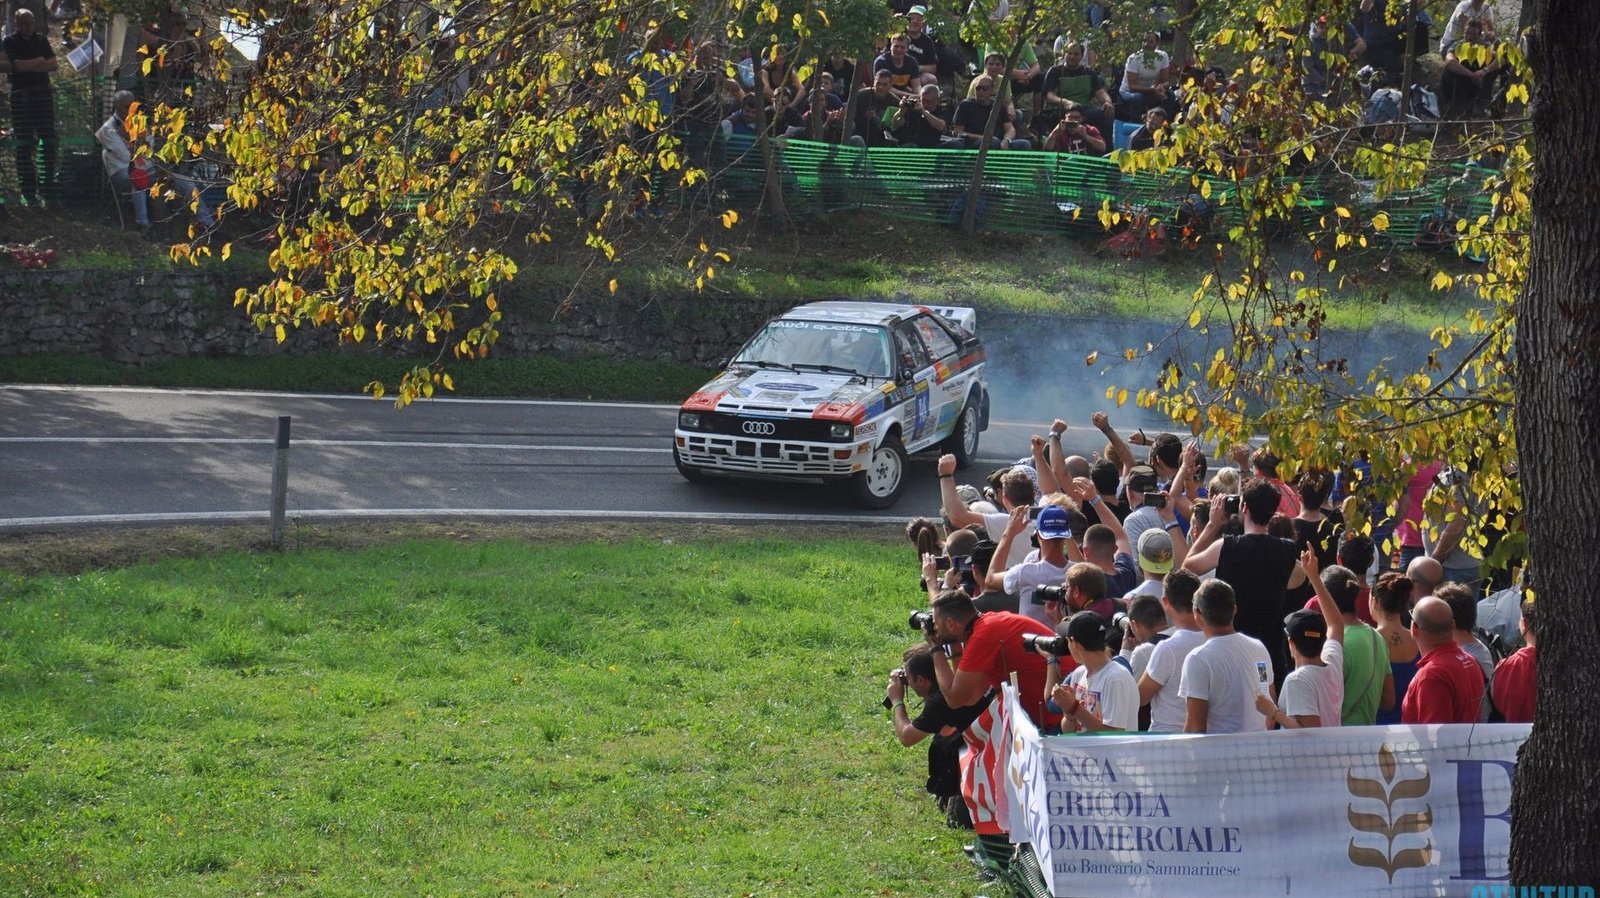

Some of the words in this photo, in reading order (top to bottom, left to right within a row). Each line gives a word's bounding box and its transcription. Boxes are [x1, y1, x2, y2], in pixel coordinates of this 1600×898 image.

[813, 323, 879, 334] quattro
[1045, 756, 1118, 784] ANCA
[1046, 789, 1171, 818] GRICOLA
[1049, 823, 1242, 854] OMMERCIALE
[1081, 858, 1142, 876] Bancario
[1146, 859, 1241, 877] Sammarinese
